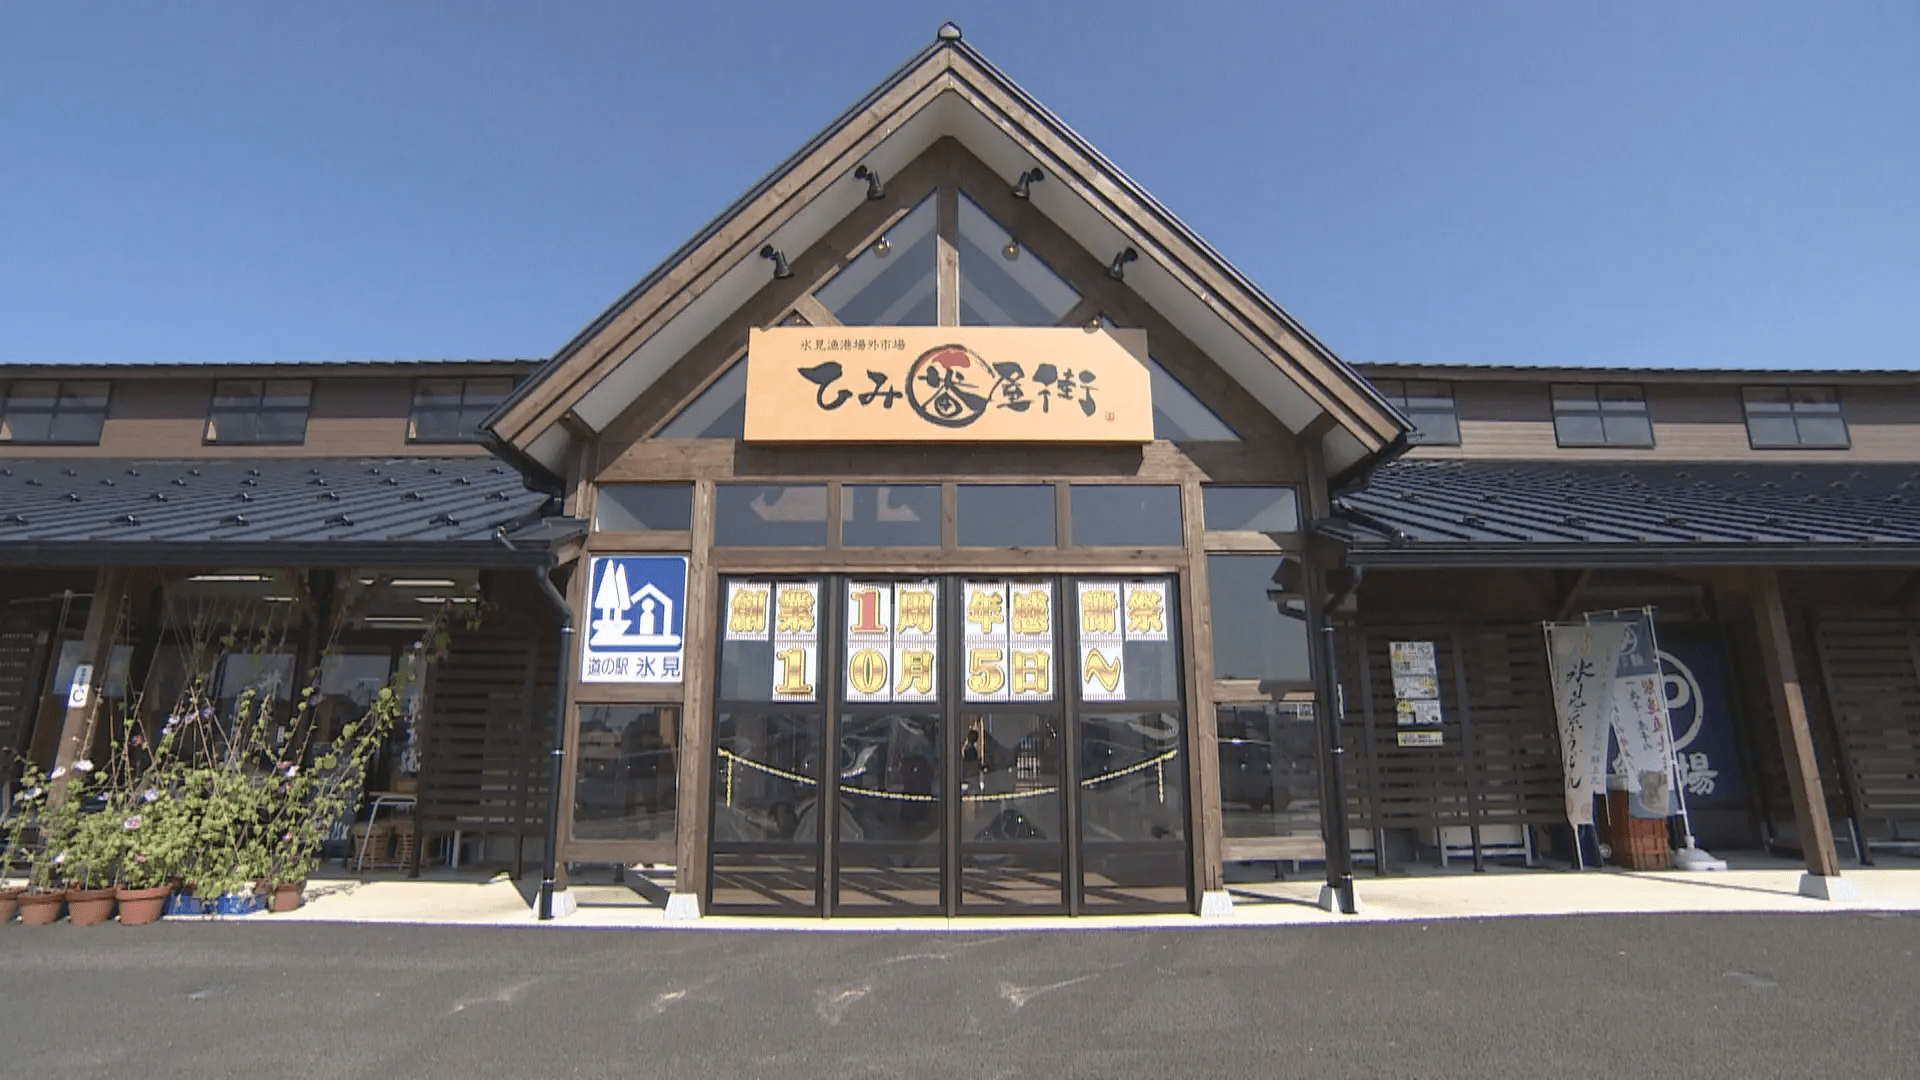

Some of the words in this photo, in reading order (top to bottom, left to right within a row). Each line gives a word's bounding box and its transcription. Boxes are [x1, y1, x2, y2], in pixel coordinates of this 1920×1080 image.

[797, 345, 1099, 427] ひみ番屋街
[588, 657, 629, 676] 道の駅
[636, 656, 680, 678] 氷見
